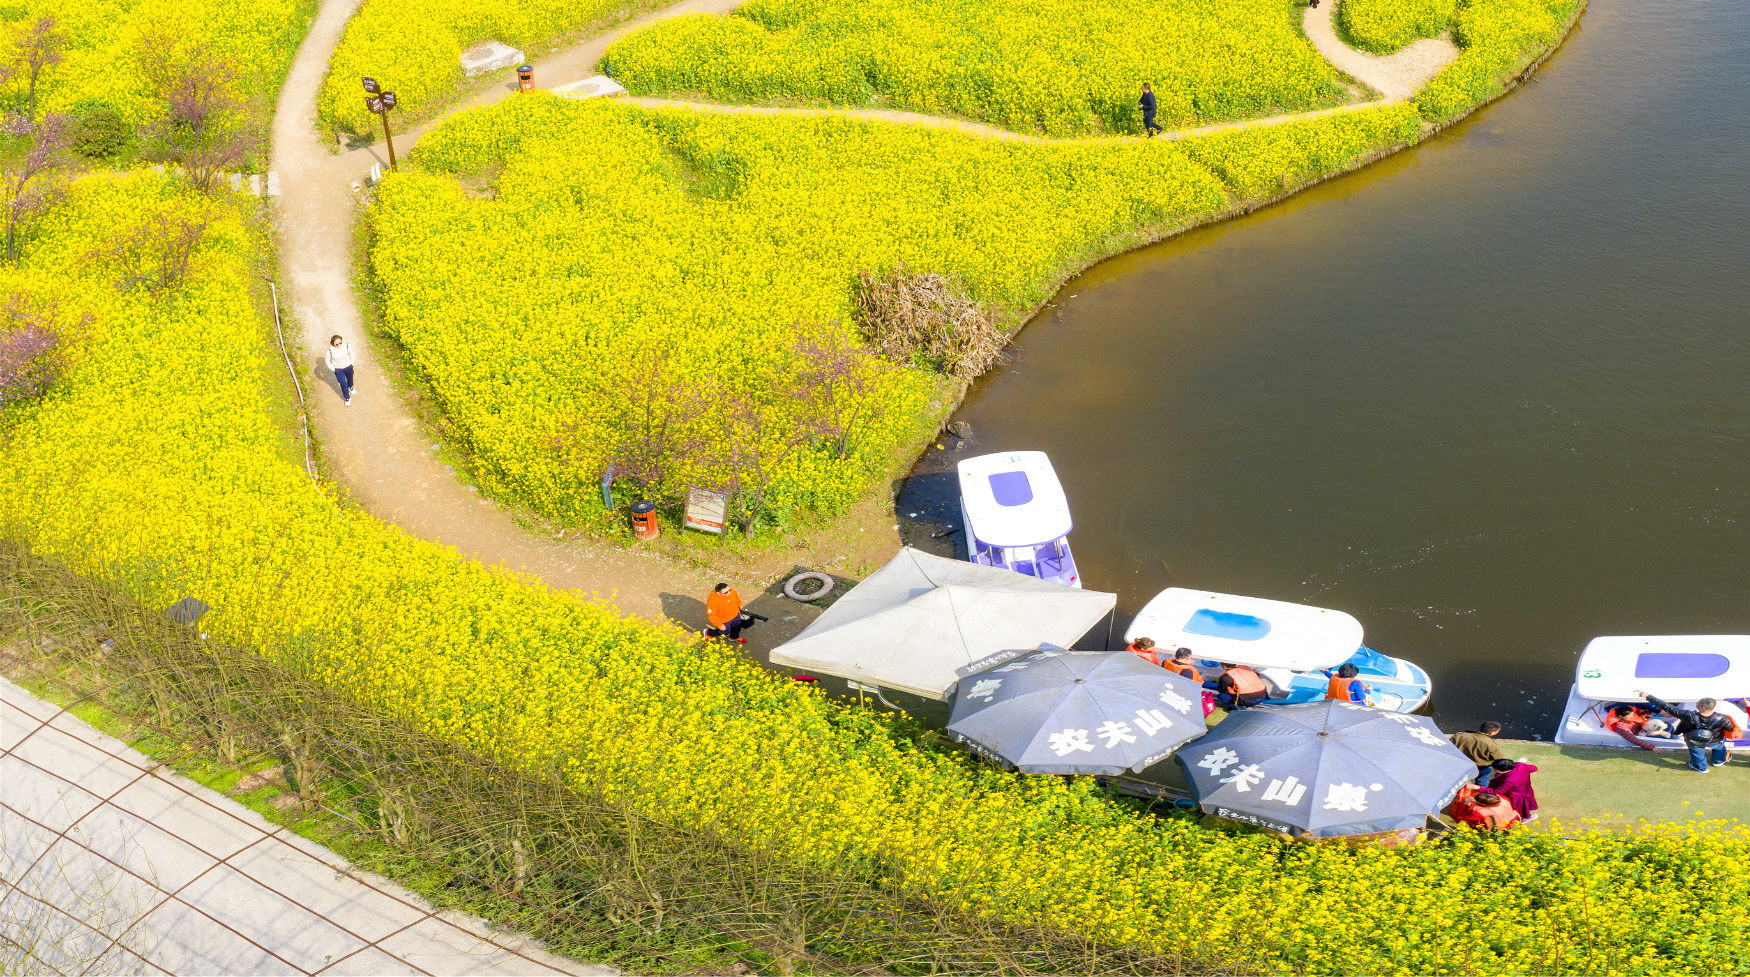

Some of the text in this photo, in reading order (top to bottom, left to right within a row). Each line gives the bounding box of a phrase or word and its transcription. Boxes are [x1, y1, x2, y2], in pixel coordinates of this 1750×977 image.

[1583, 668, 1602, 679] 13
[1048, 688, 1193, 757] 农夫山泉
[1197, 746, 1370, 813] 农夫山泉
